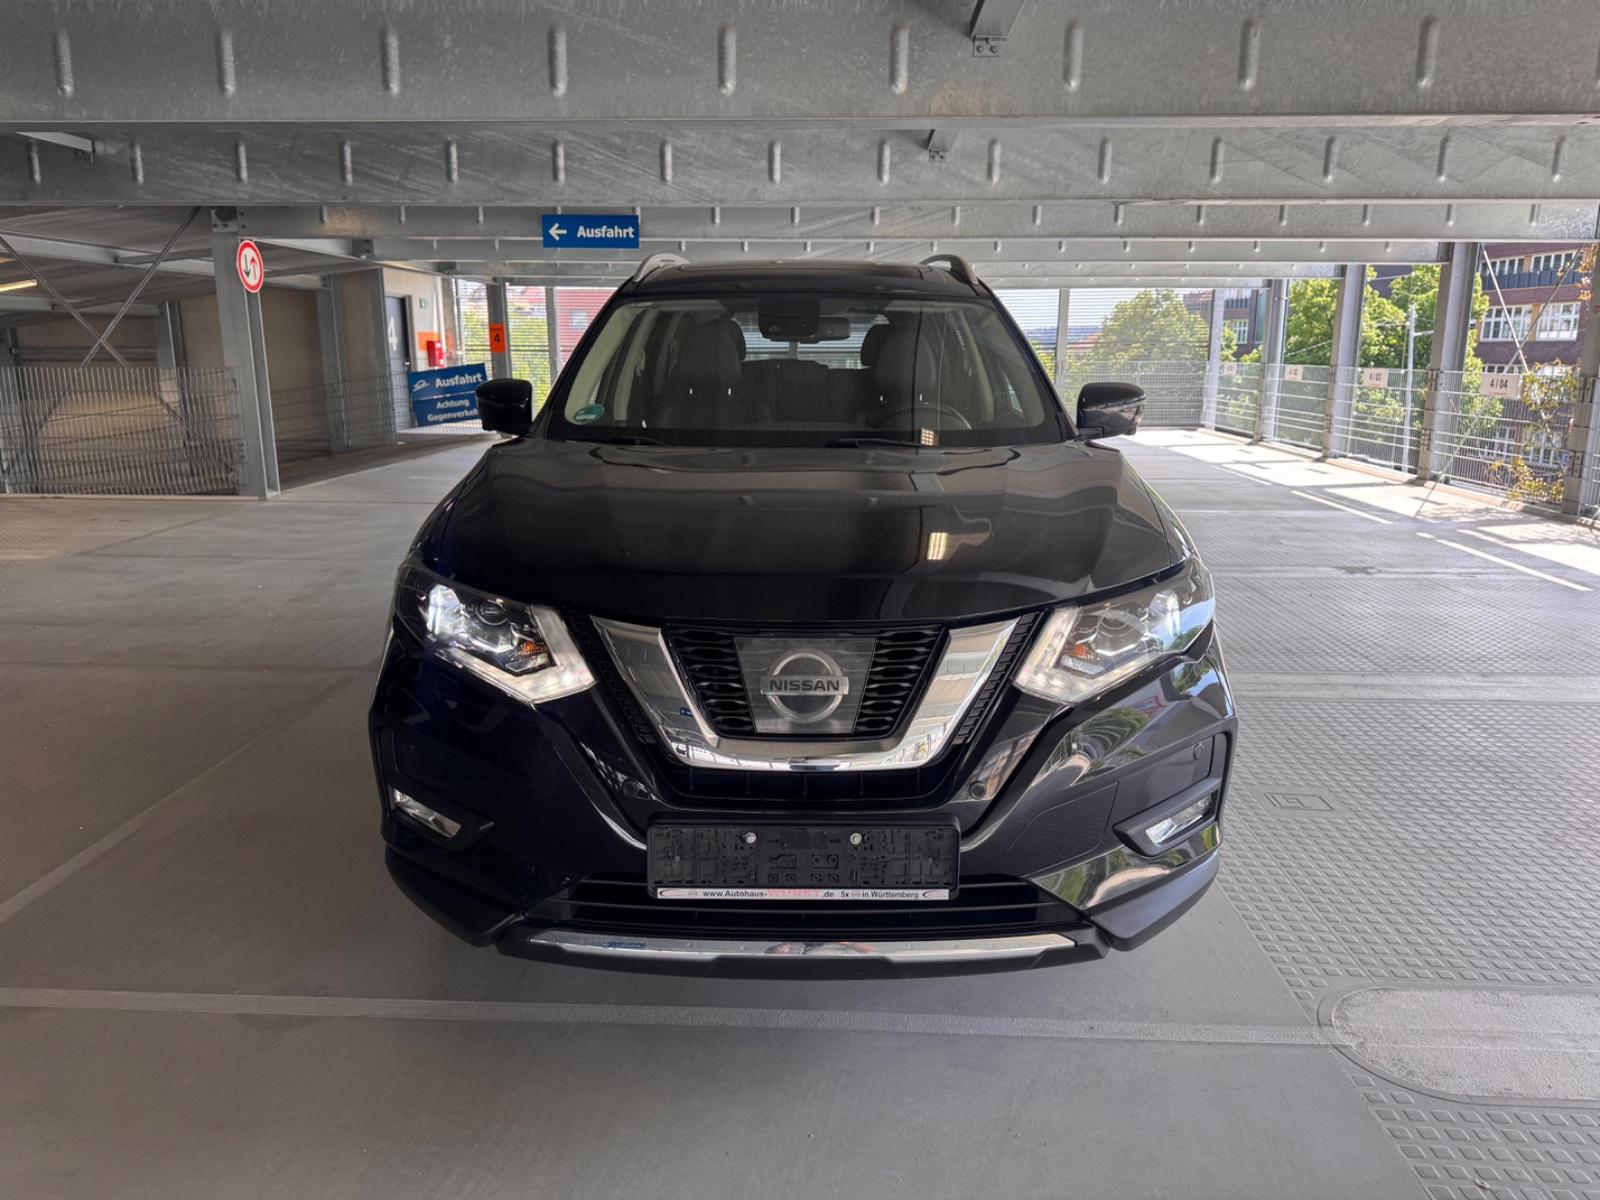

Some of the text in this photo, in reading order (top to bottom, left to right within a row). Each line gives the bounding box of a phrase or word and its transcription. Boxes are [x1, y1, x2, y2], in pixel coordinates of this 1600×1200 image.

[577, 225, 635, 239] Ausfahrt
[387, 316, 398, 351] 4
[494, 332, 501, 343] 4
[435, 373, 484, 389] Ausfahrt
[436, 399, 470, 410] Achtung
[427, 408, 479, 421] Gegenverkeh
[769, 679, 839, 692] NISSAN
[862, 888, 870, 897] in
[871, 888, 919, 899] Württemberg
